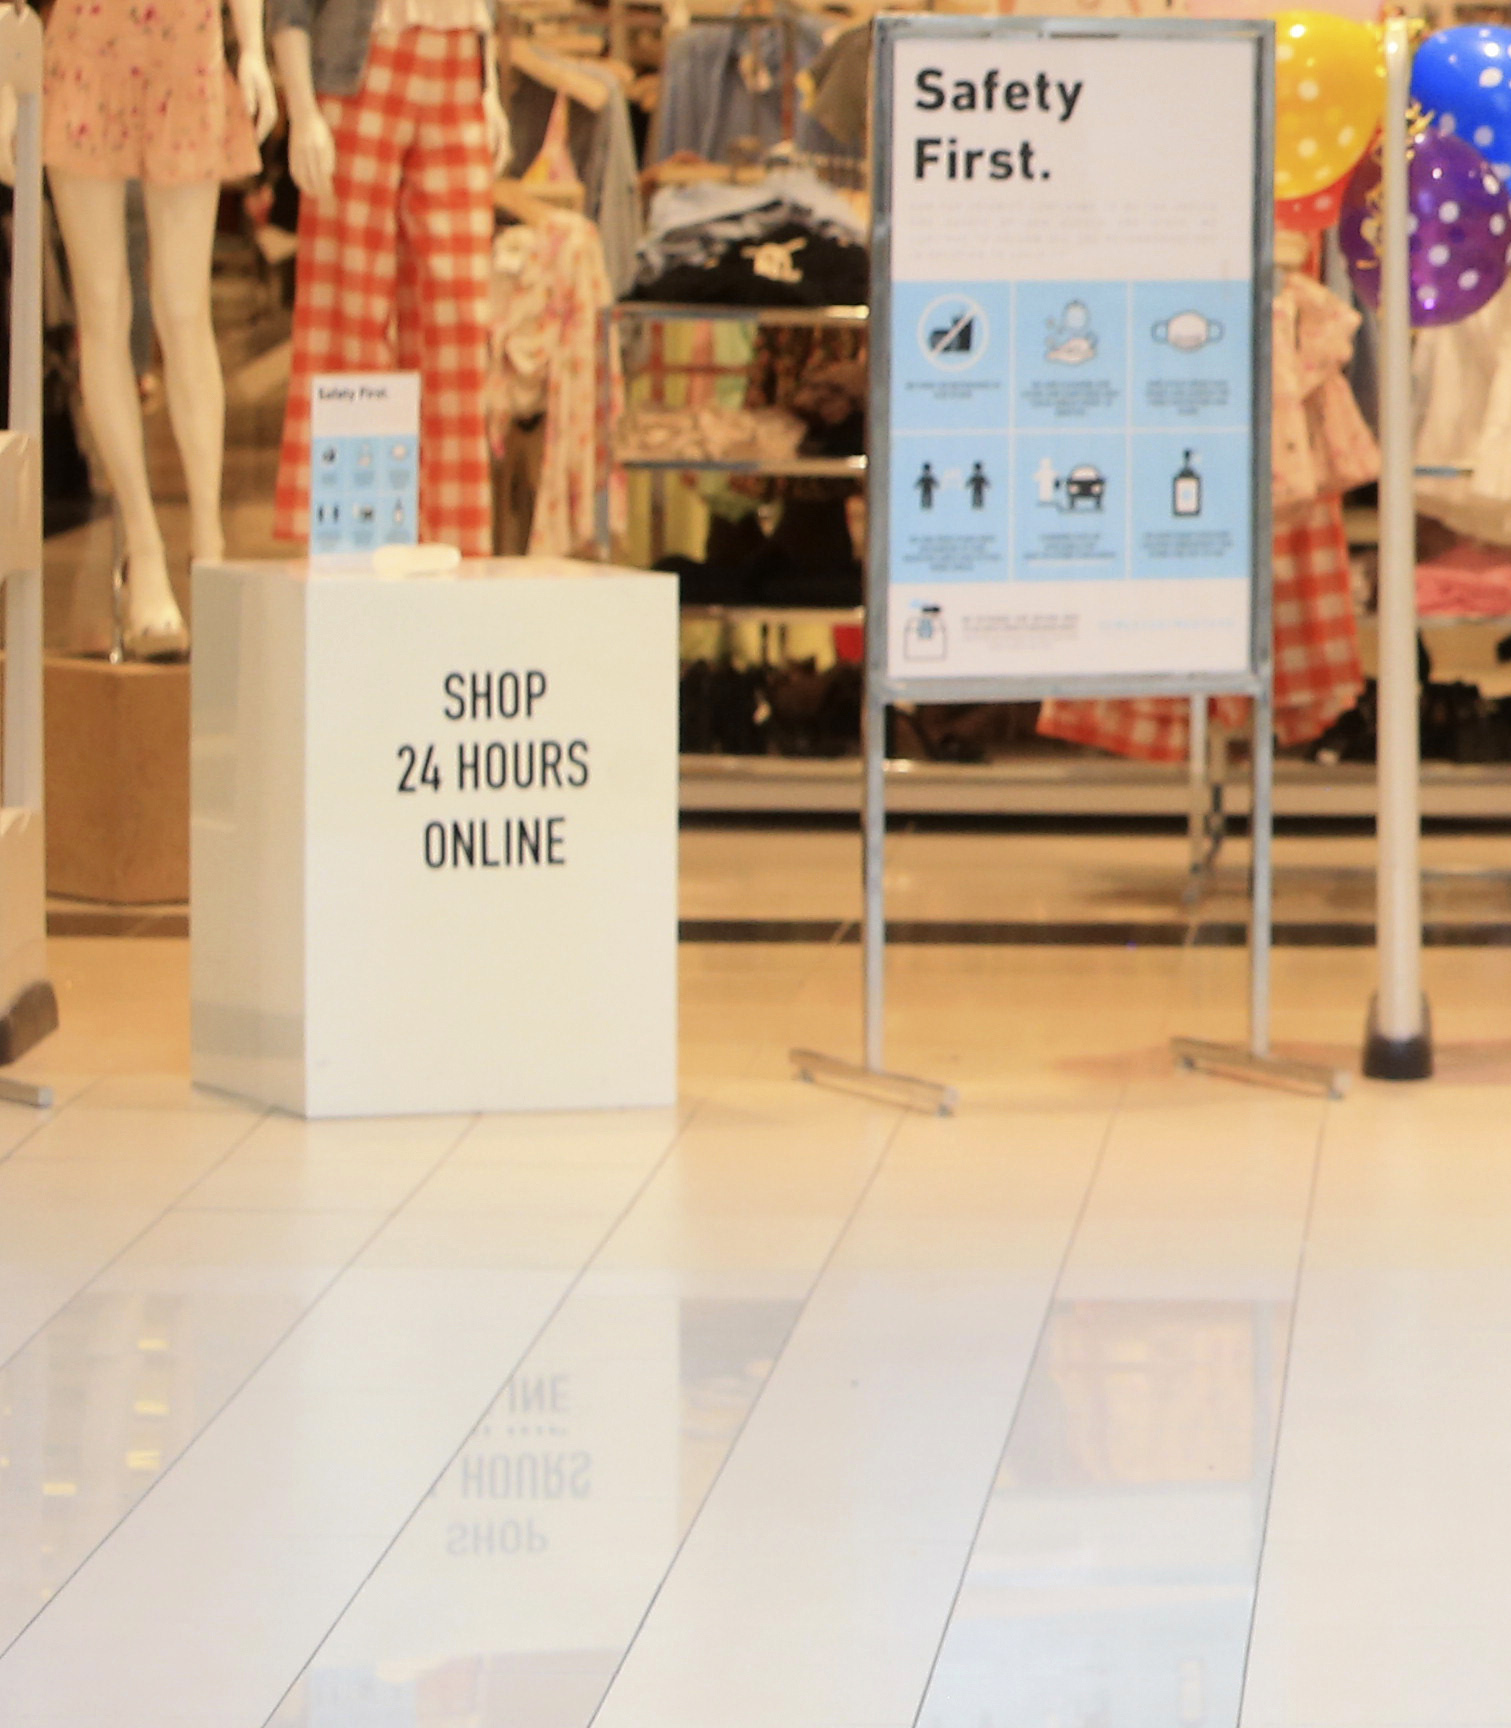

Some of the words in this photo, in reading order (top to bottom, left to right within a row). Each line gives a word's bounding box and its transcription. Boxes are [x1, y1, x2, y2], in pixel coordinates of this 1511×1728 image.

[916, 69, 1082, 122] Safety
[916, 139, 1049, 180] First.
[318, 388, 355, 401] Safety
[445, 671, 546, 720] SHOP
[398, 746, 440, 792] 24
[459, 741, 588, 790] HOURS
[425, 818, 564, 868] ONLINE
